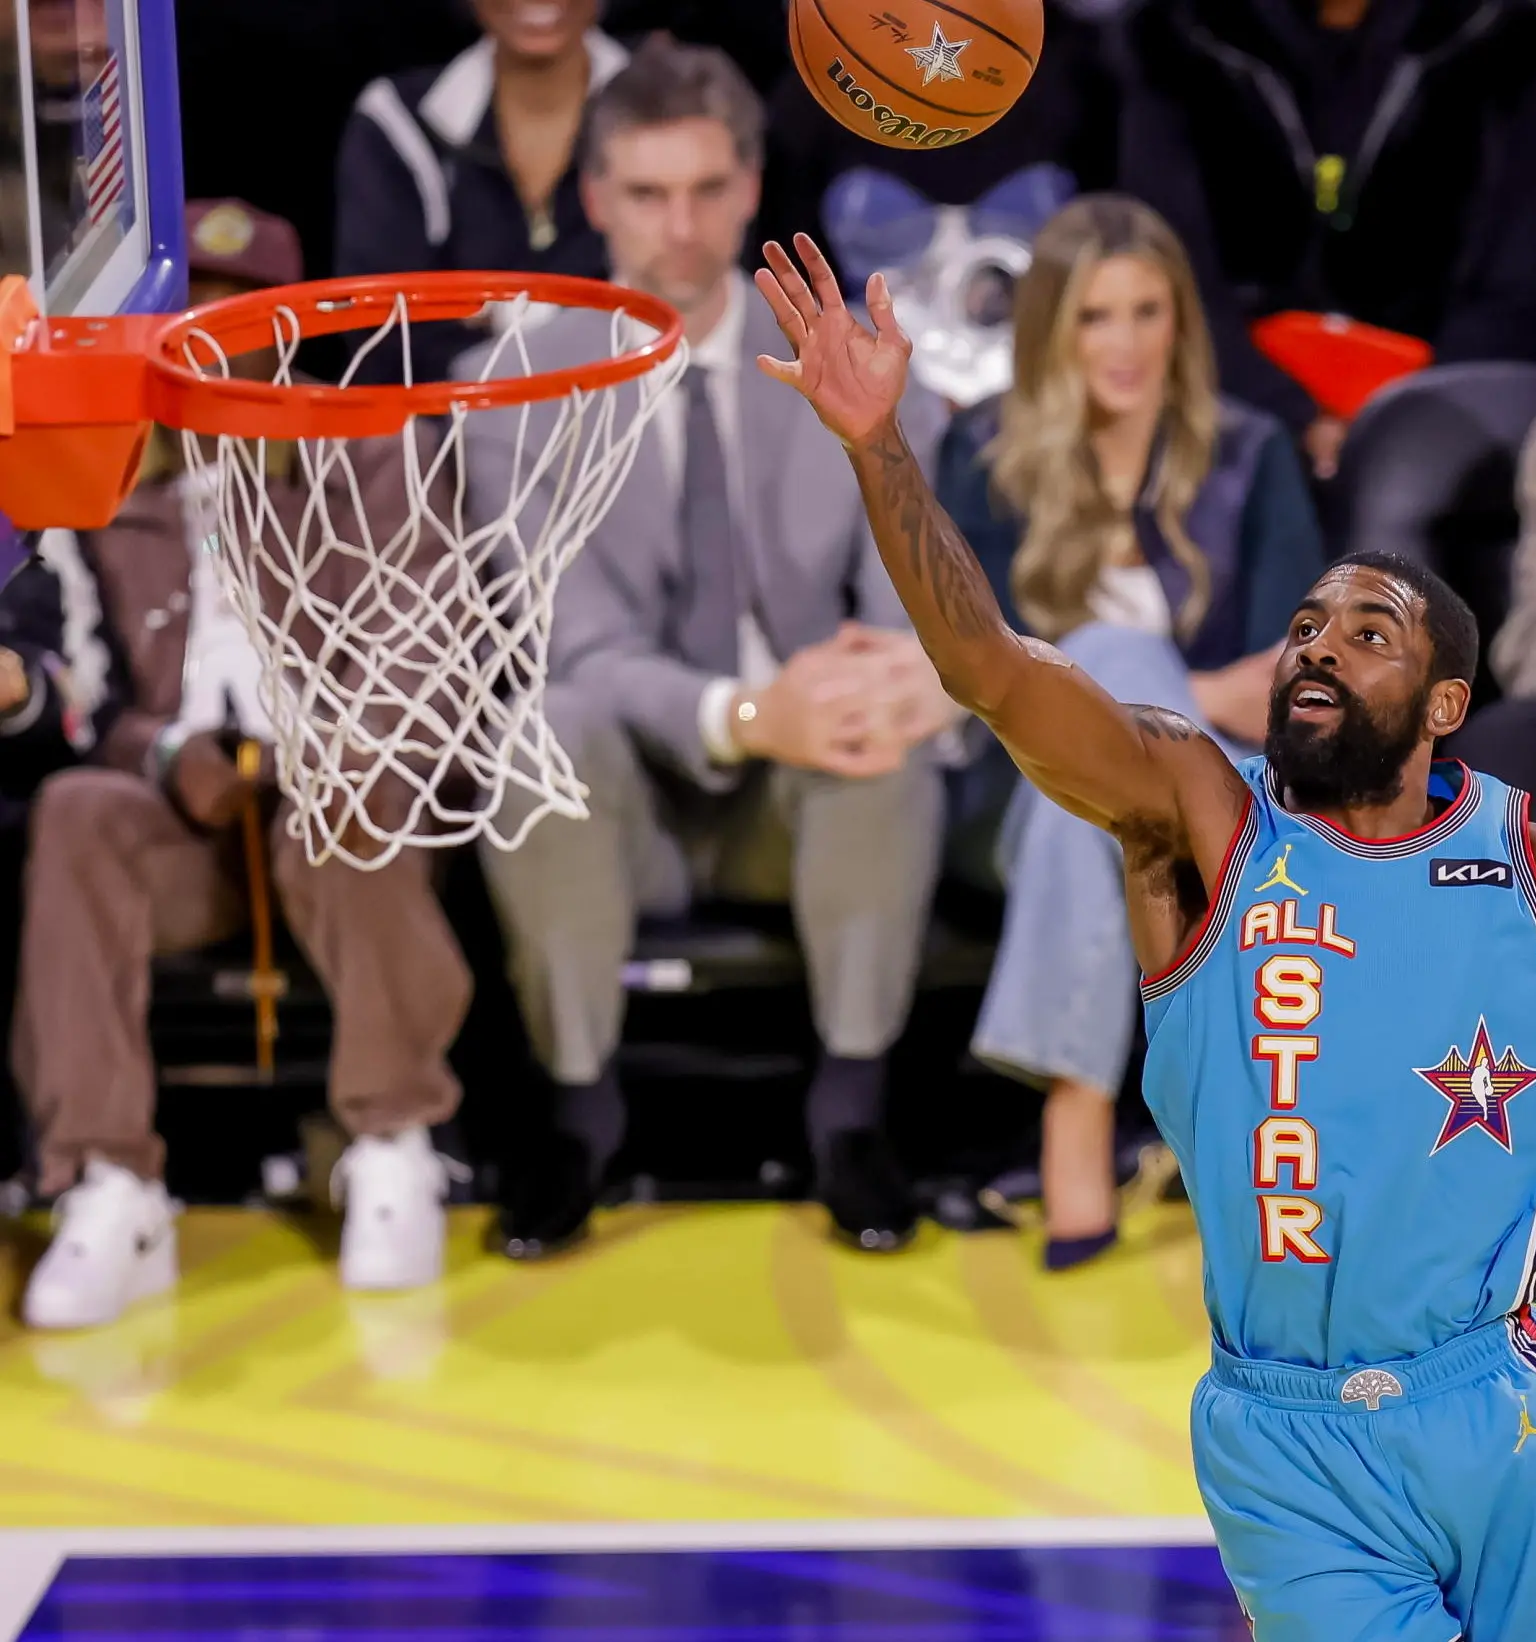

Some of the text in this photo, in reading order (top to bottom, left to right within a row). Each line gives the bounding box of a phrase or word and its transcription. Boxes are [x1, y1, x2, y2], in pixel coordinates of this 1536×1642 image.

[1437, 864, 1506, 882] KIA
[1239, 899, 1356, 959] ALL
[1252, 954, 1333, 1264] STAR
